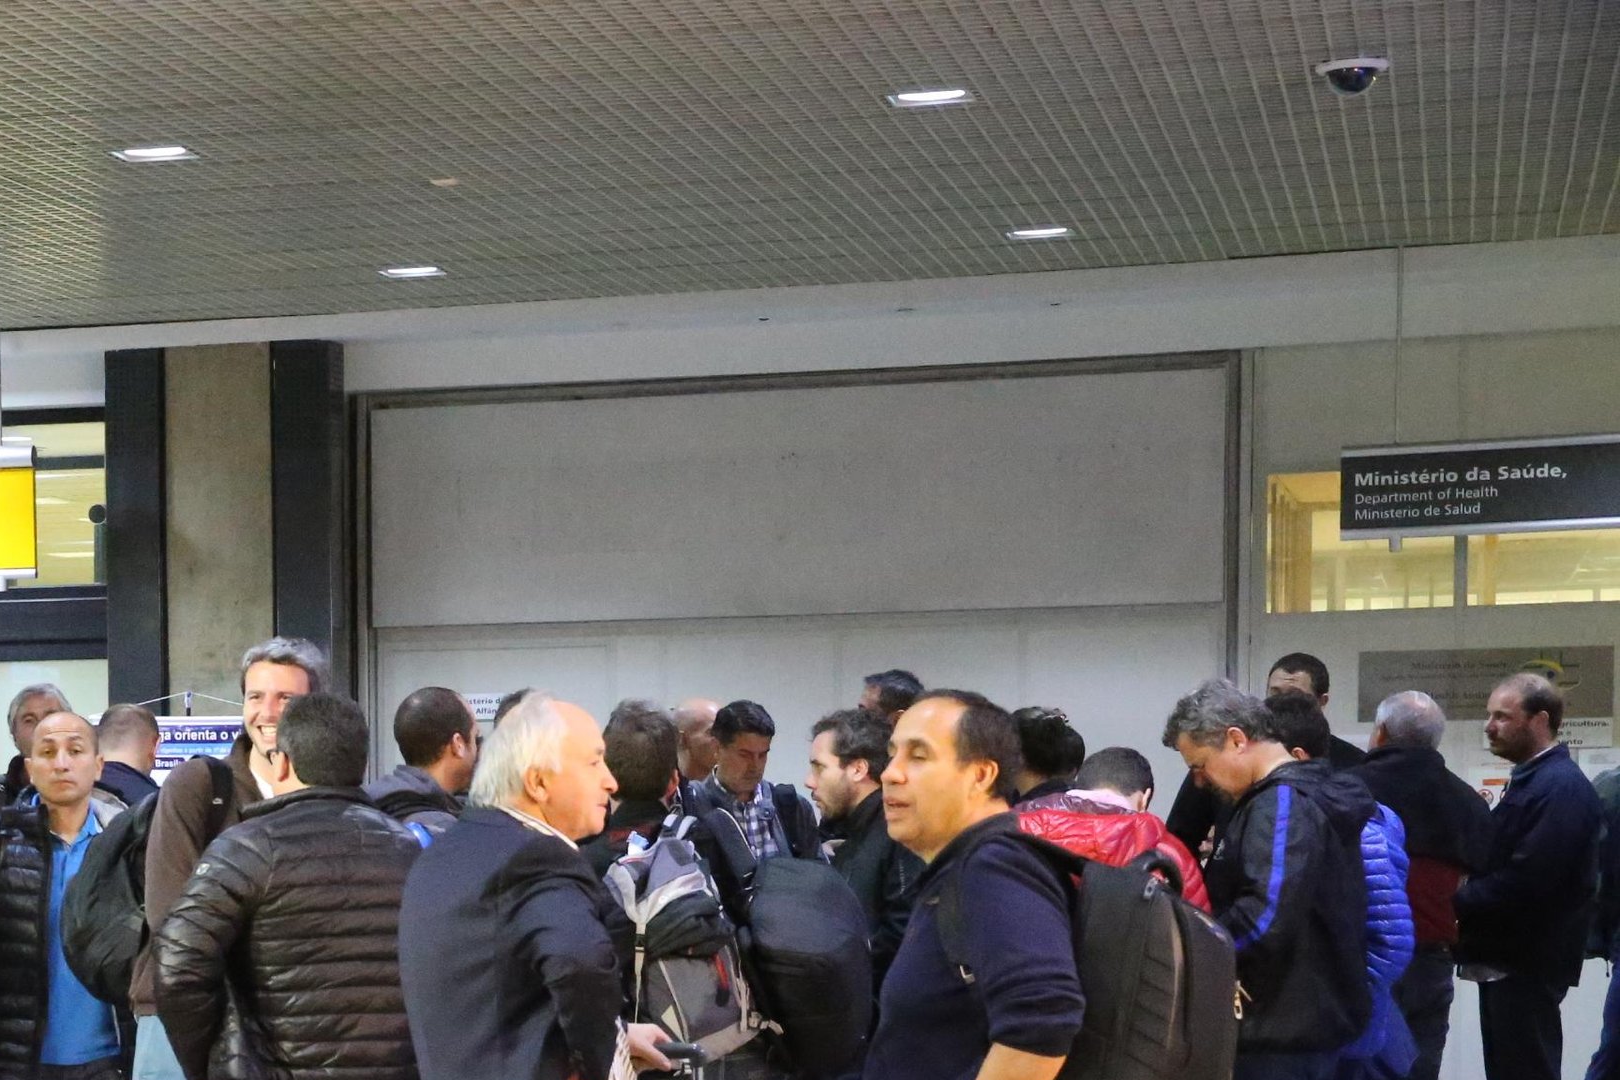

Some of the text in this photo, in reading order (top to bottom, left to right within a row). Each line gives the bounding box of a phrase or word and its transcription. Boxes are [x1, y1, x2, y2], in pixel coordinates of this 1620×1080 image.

[1354, 463, 1568, 487] Ministério da Saúde,
[1354, 486, 1499, 505] Department of Health
[1354, 502, 1481, 521] Ministerio de Salud
[174, 729, 217, 741] orienta
[220, 731, 229, 741] o
